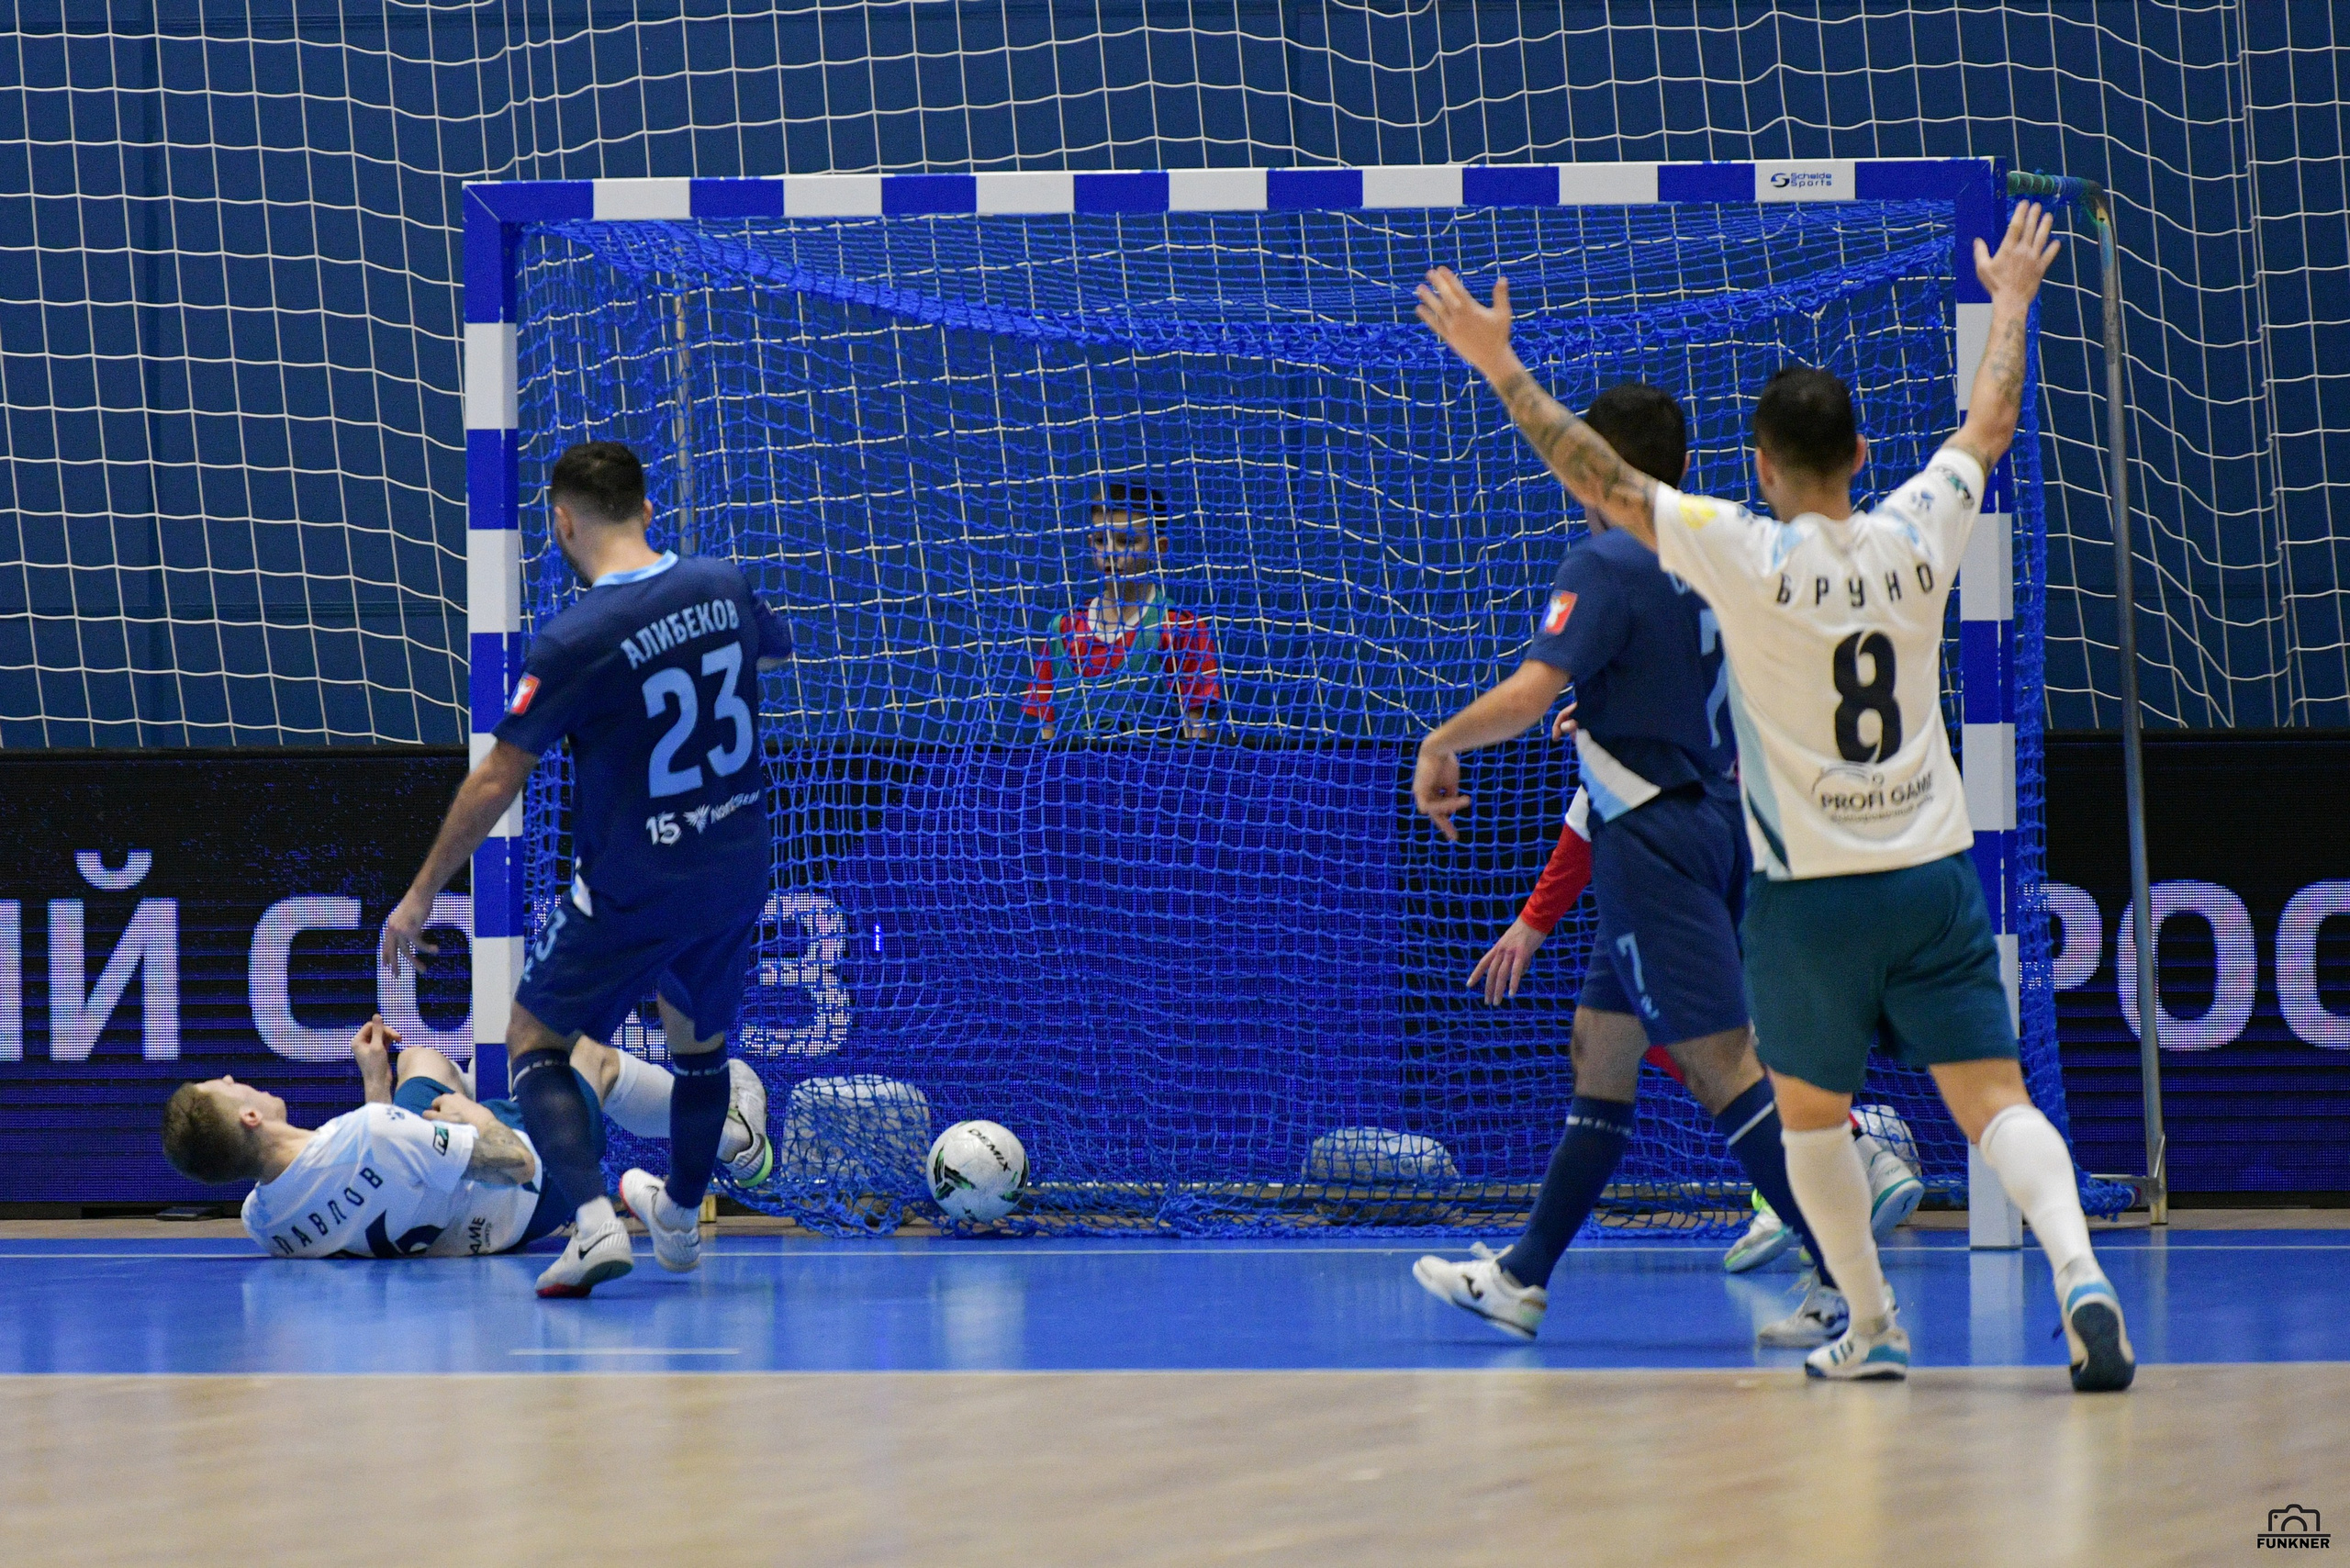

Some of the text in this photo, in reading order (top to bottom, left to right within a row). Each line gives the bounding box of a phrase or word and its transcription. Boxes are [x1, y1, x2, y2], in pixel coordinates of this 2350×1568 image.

[1790, 172, 1832, 180] Schelde
[1790, 180, 1832, 188] Sports
[1776, 563, 1935, 607] БРУНО
[621, 599, 740, 670] АЛИБЕКОВ
[643, 642, 754, 799] 23
[1831, 630, 1903, 765] 8
[1820, 790, 1885, 811] PROFI
[645, 811, 682, 846] 15
[0, 848, 181, 1062] Й
[248, 892, 851, 1062] СОЗ
[1616, 931, 1645, 992] 7
[272, 1167, 384, 1255] ПАВЛОВ
[467, 1215, 487, 1256] AME
